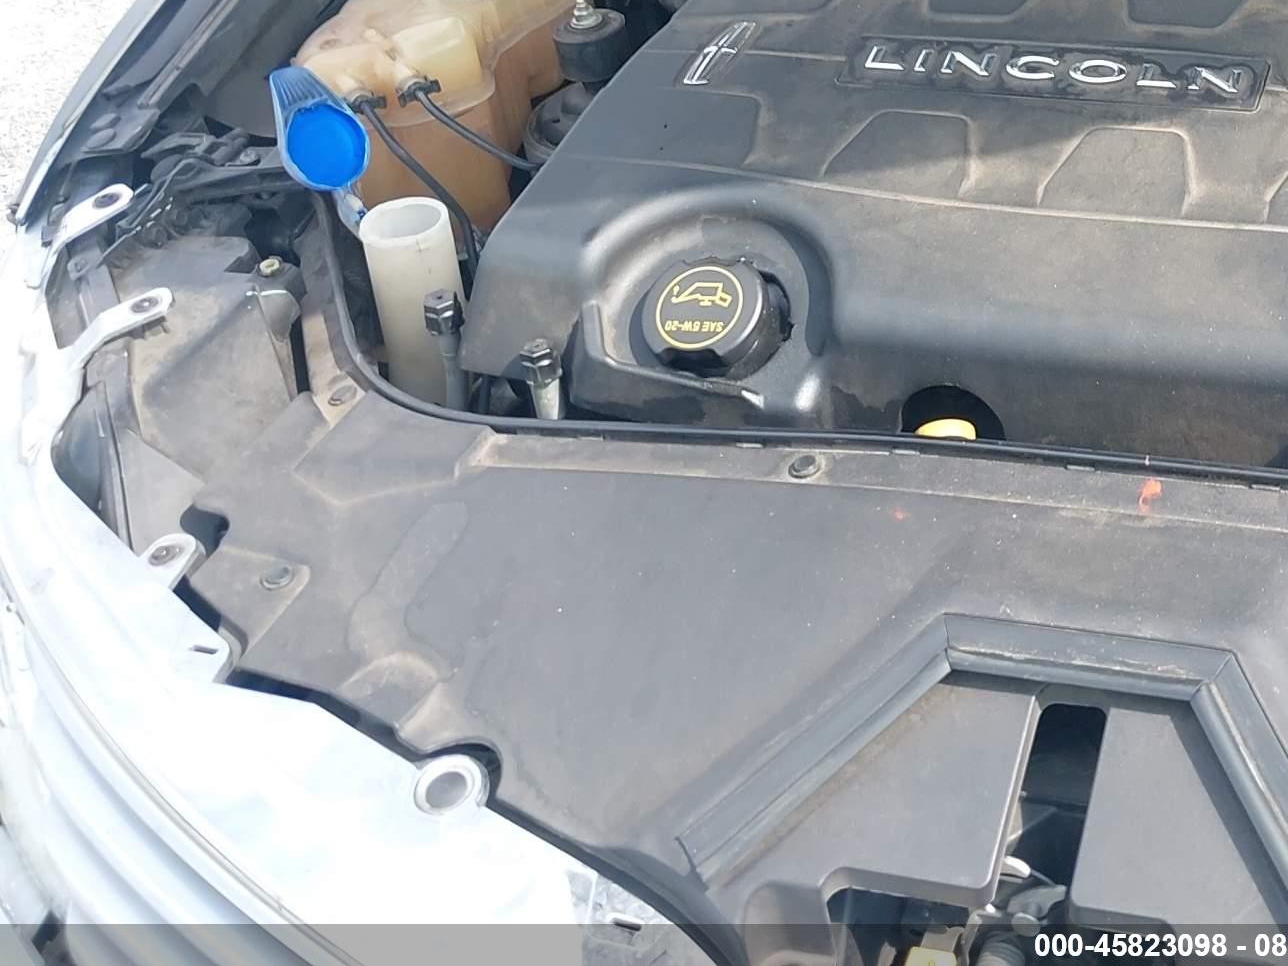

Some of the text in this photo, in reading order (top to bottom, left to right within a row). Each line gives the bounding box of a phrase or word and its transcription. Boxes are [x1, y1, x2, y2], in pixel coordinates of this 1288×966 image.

[863, 43, 1244, 94] LINCOLN
[664, 320, 723, 333] SAE 5W-20
